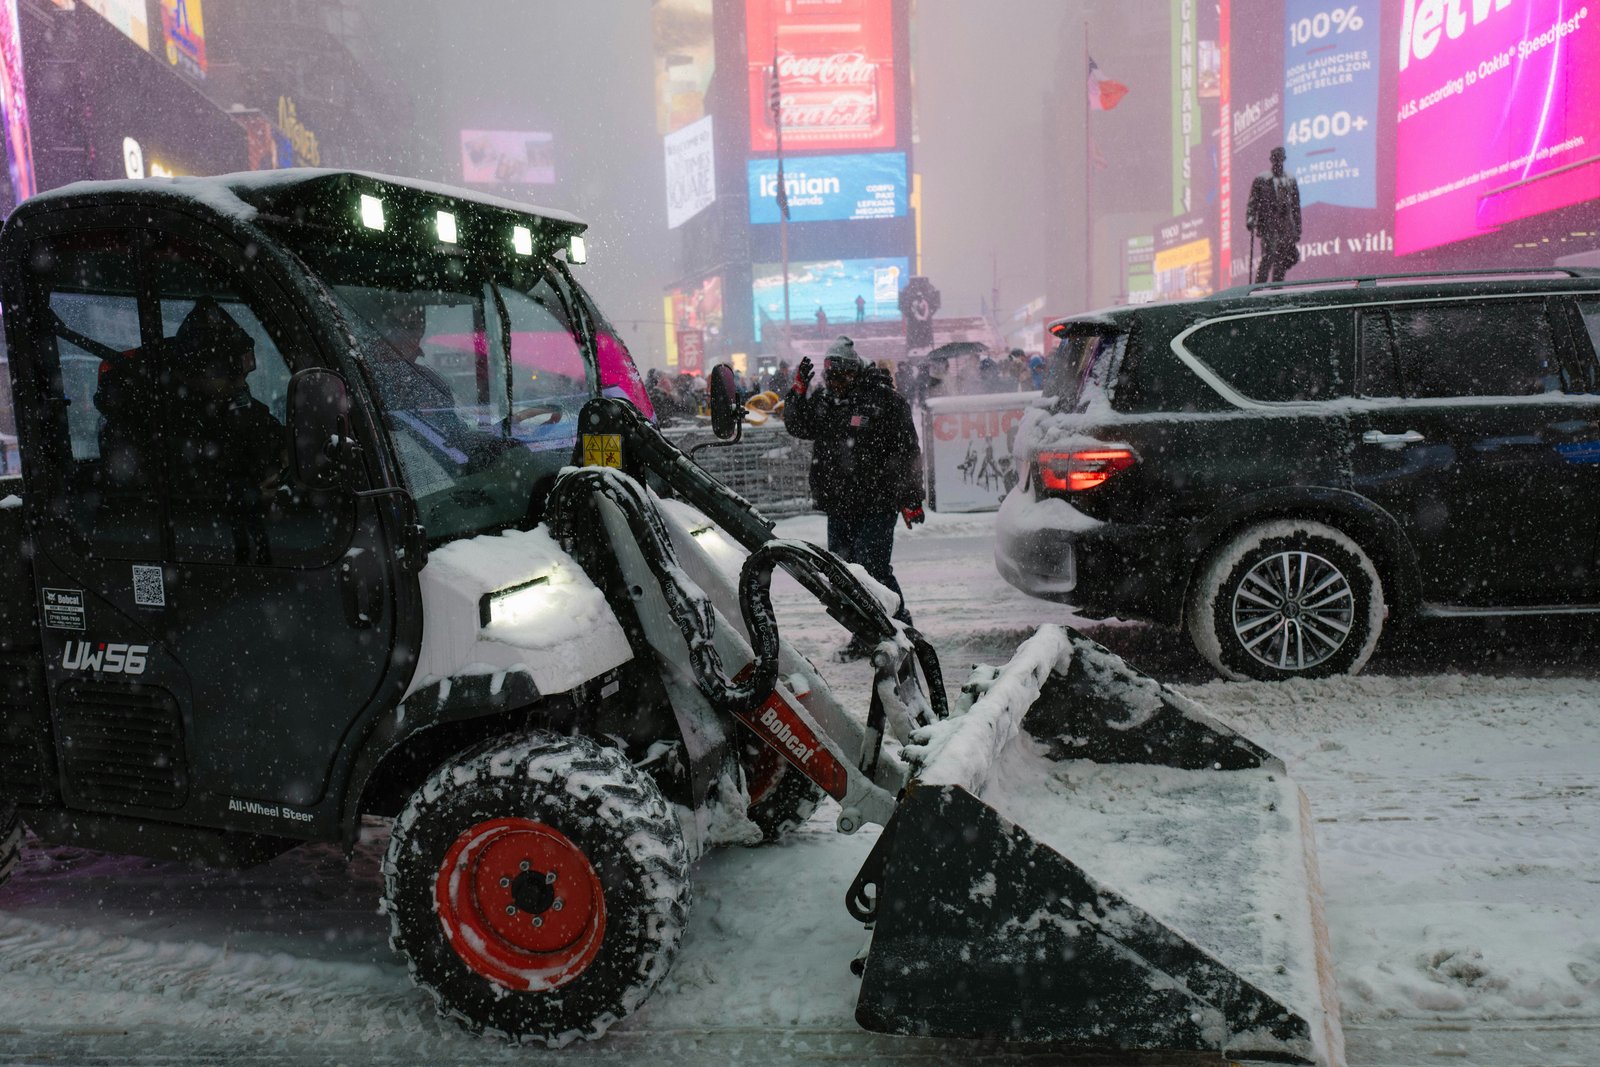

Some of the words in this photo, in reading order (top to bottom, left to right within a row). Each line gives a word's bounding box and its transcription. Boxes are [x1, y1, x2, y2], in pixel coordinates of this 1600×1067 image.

[1290, 6, 1364, 47] 100%
[1285, 70, 1317, 88] ACHIEVE
[1320, 61, 1370, 77] AMAZON
[1308, 50, 1368, 70] LAUNCHES
[1181, 0, 1191, 178] CANNABIS
[1293, 82, 1312, 95] BEST
[1315, 73, 1353, 89] SELLER
[1402, 99, 1418, 119] U.S.
[1419, 77, 1463, 110] according
[1465, 70, 1476, 86] to
[1233, 101, 1261, 136] Forbes
[1287, 111, 1368, 145] 4500+
[1221, 103, 1230, 193] HERSHEY'S
[1310, 158, 1348, 171] MEDIA
[1299, 168, 1359, 185] ACEMENTS
[787, 195, 824, 206] slands
[1221, 198, 1230, 250] STORE
[1297, 236, 1341, 262] pact
[1347, 229, 1394, 252] with
[683, 334, 698, 367] tkts
[57, 594, 79, 605] Bobcat
[62, 640, 149, 675] UW56
[760, 707, 815, 764] Bobcat
[228, 799, 279, 817] All-Wheel
[282, 807, 314, 822] Steer
